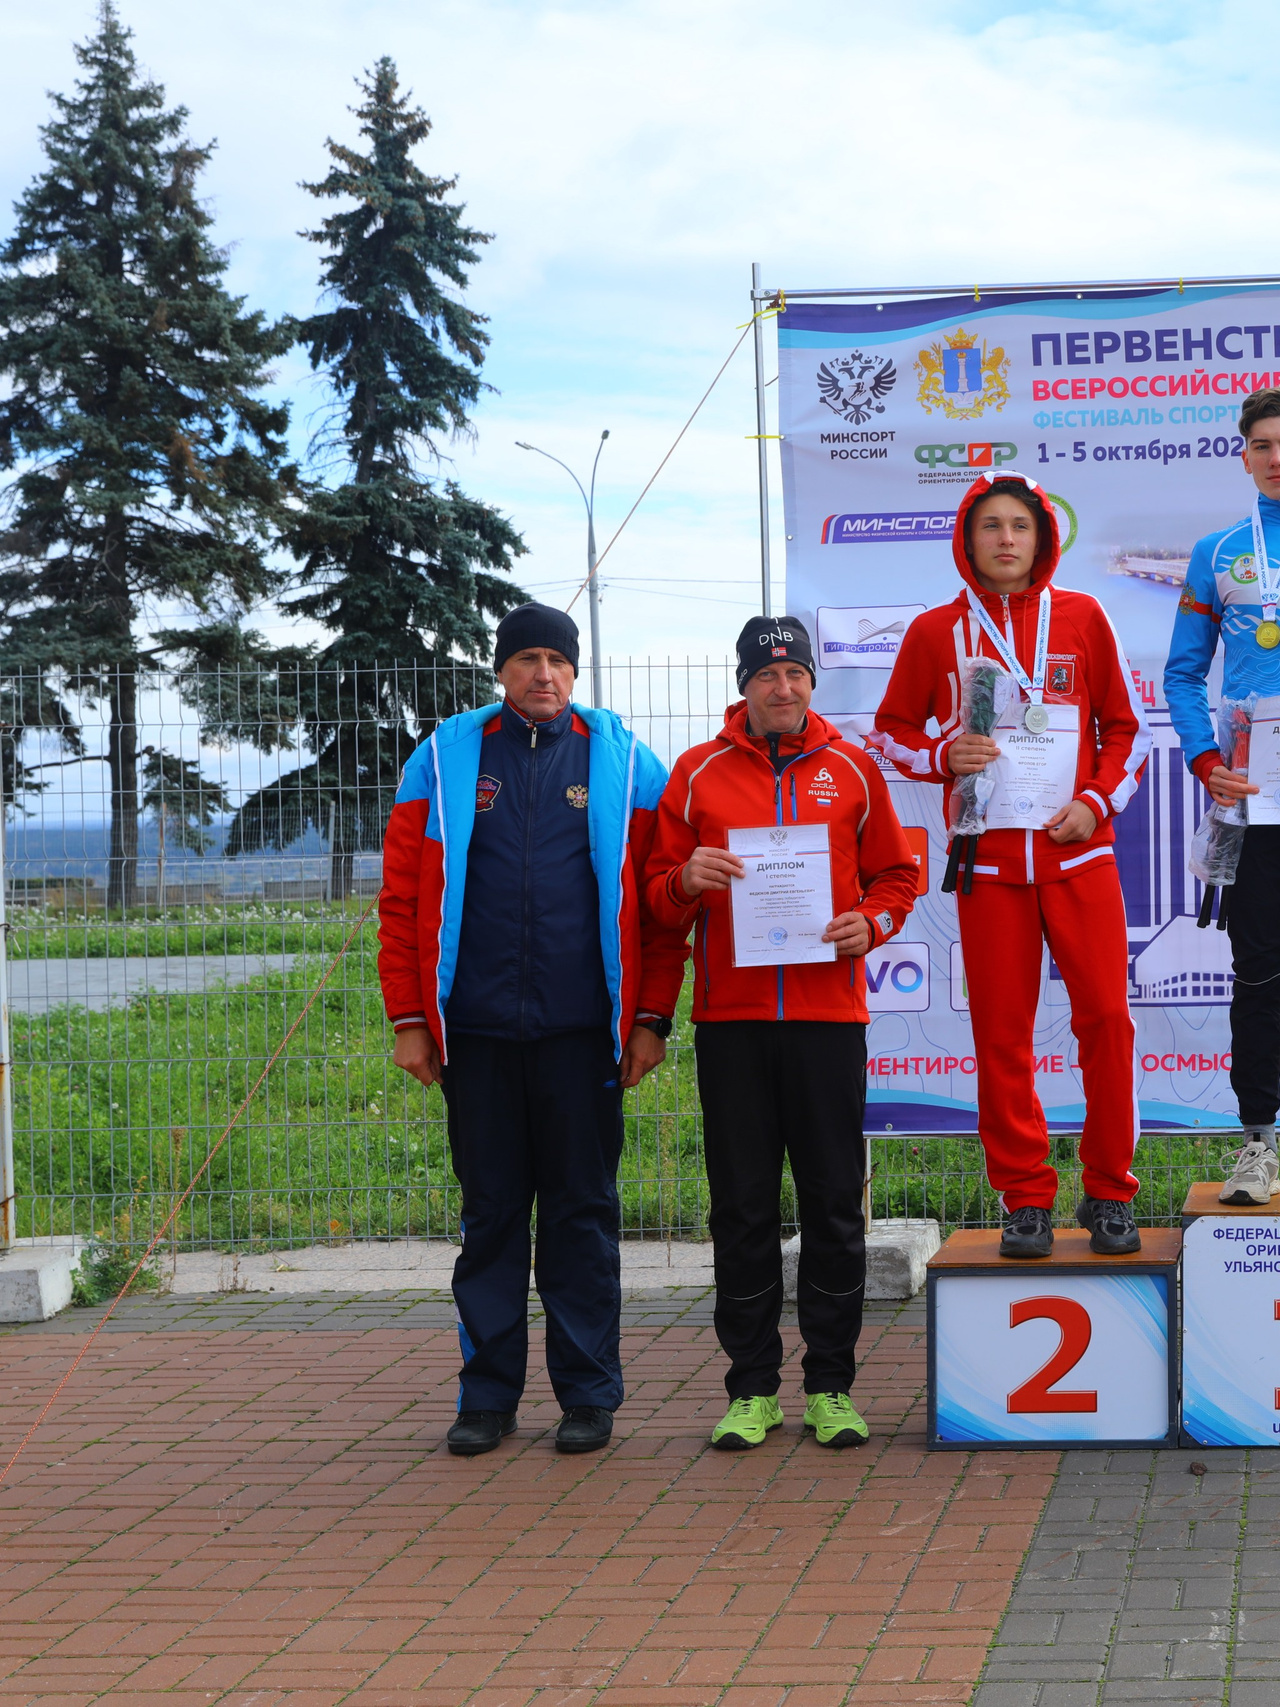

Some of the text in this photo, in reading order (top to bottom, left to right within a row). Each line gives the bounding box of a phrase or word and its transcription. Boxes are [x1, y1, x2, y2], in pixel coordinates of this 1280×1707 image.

[1033, 407, 1164, 429] ФЕСТИВАЛЬ
[820, 431, 896, 444] МИНСПОРТ
[830, 448, 888, 460] РОССИИ
[1037, 443, 1050, 463] 1
[1073, 441, 1087, 462] 5
[1093, 439, 1191, 465] октября
[1197, 436, 1246, 458] 202
[843, 516, 957, 531] МИНСПОР
[759, 626, 794, 647] DNB
[978, 609, 1021, 674] МИНИСТЕРСТВО СПОРТА РОССИИ
[1037, 636, 1045, 672] МИНИСТЕРСТВО
[1008, 735, 1055, 744] ДИПЛОМ
[756, 861, 805, 872] ДИПЛОМ
[1006, 1294, 1098, 1414] 2
